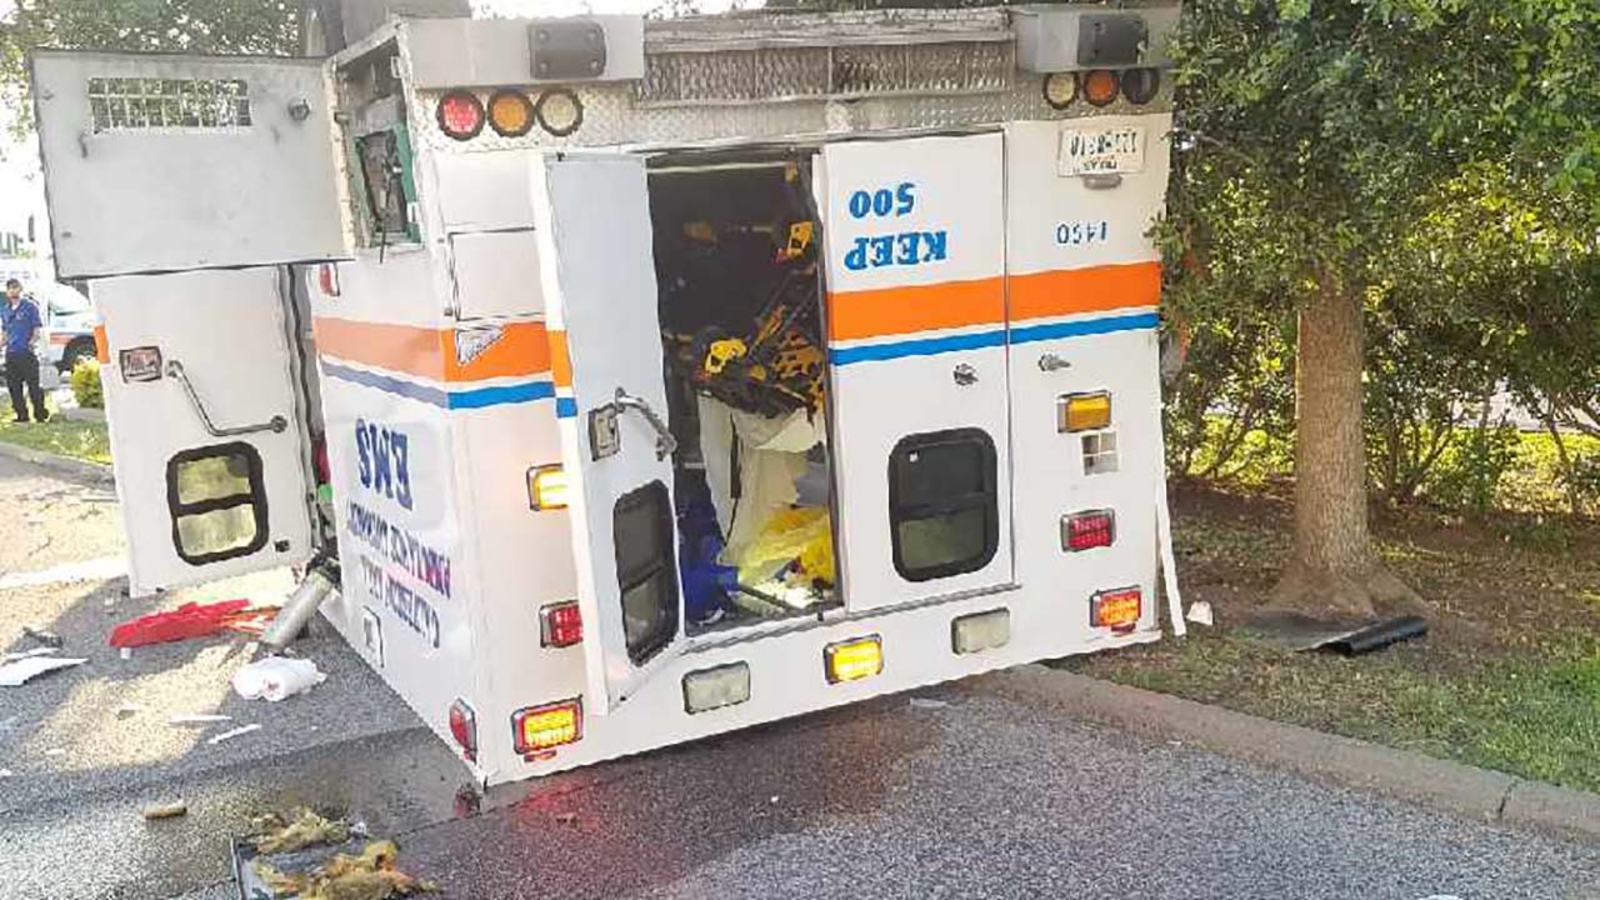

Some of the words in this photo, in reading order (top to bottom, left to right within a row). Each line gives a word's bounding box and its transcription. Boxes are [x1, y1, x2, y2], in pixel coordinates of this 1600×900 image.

[849, 182, 916, 218] 500
[844, 231, 947, 270] KEEP
[1057, 221, 1107, 244] 1450
[355, 418, 413, 511] EMS
